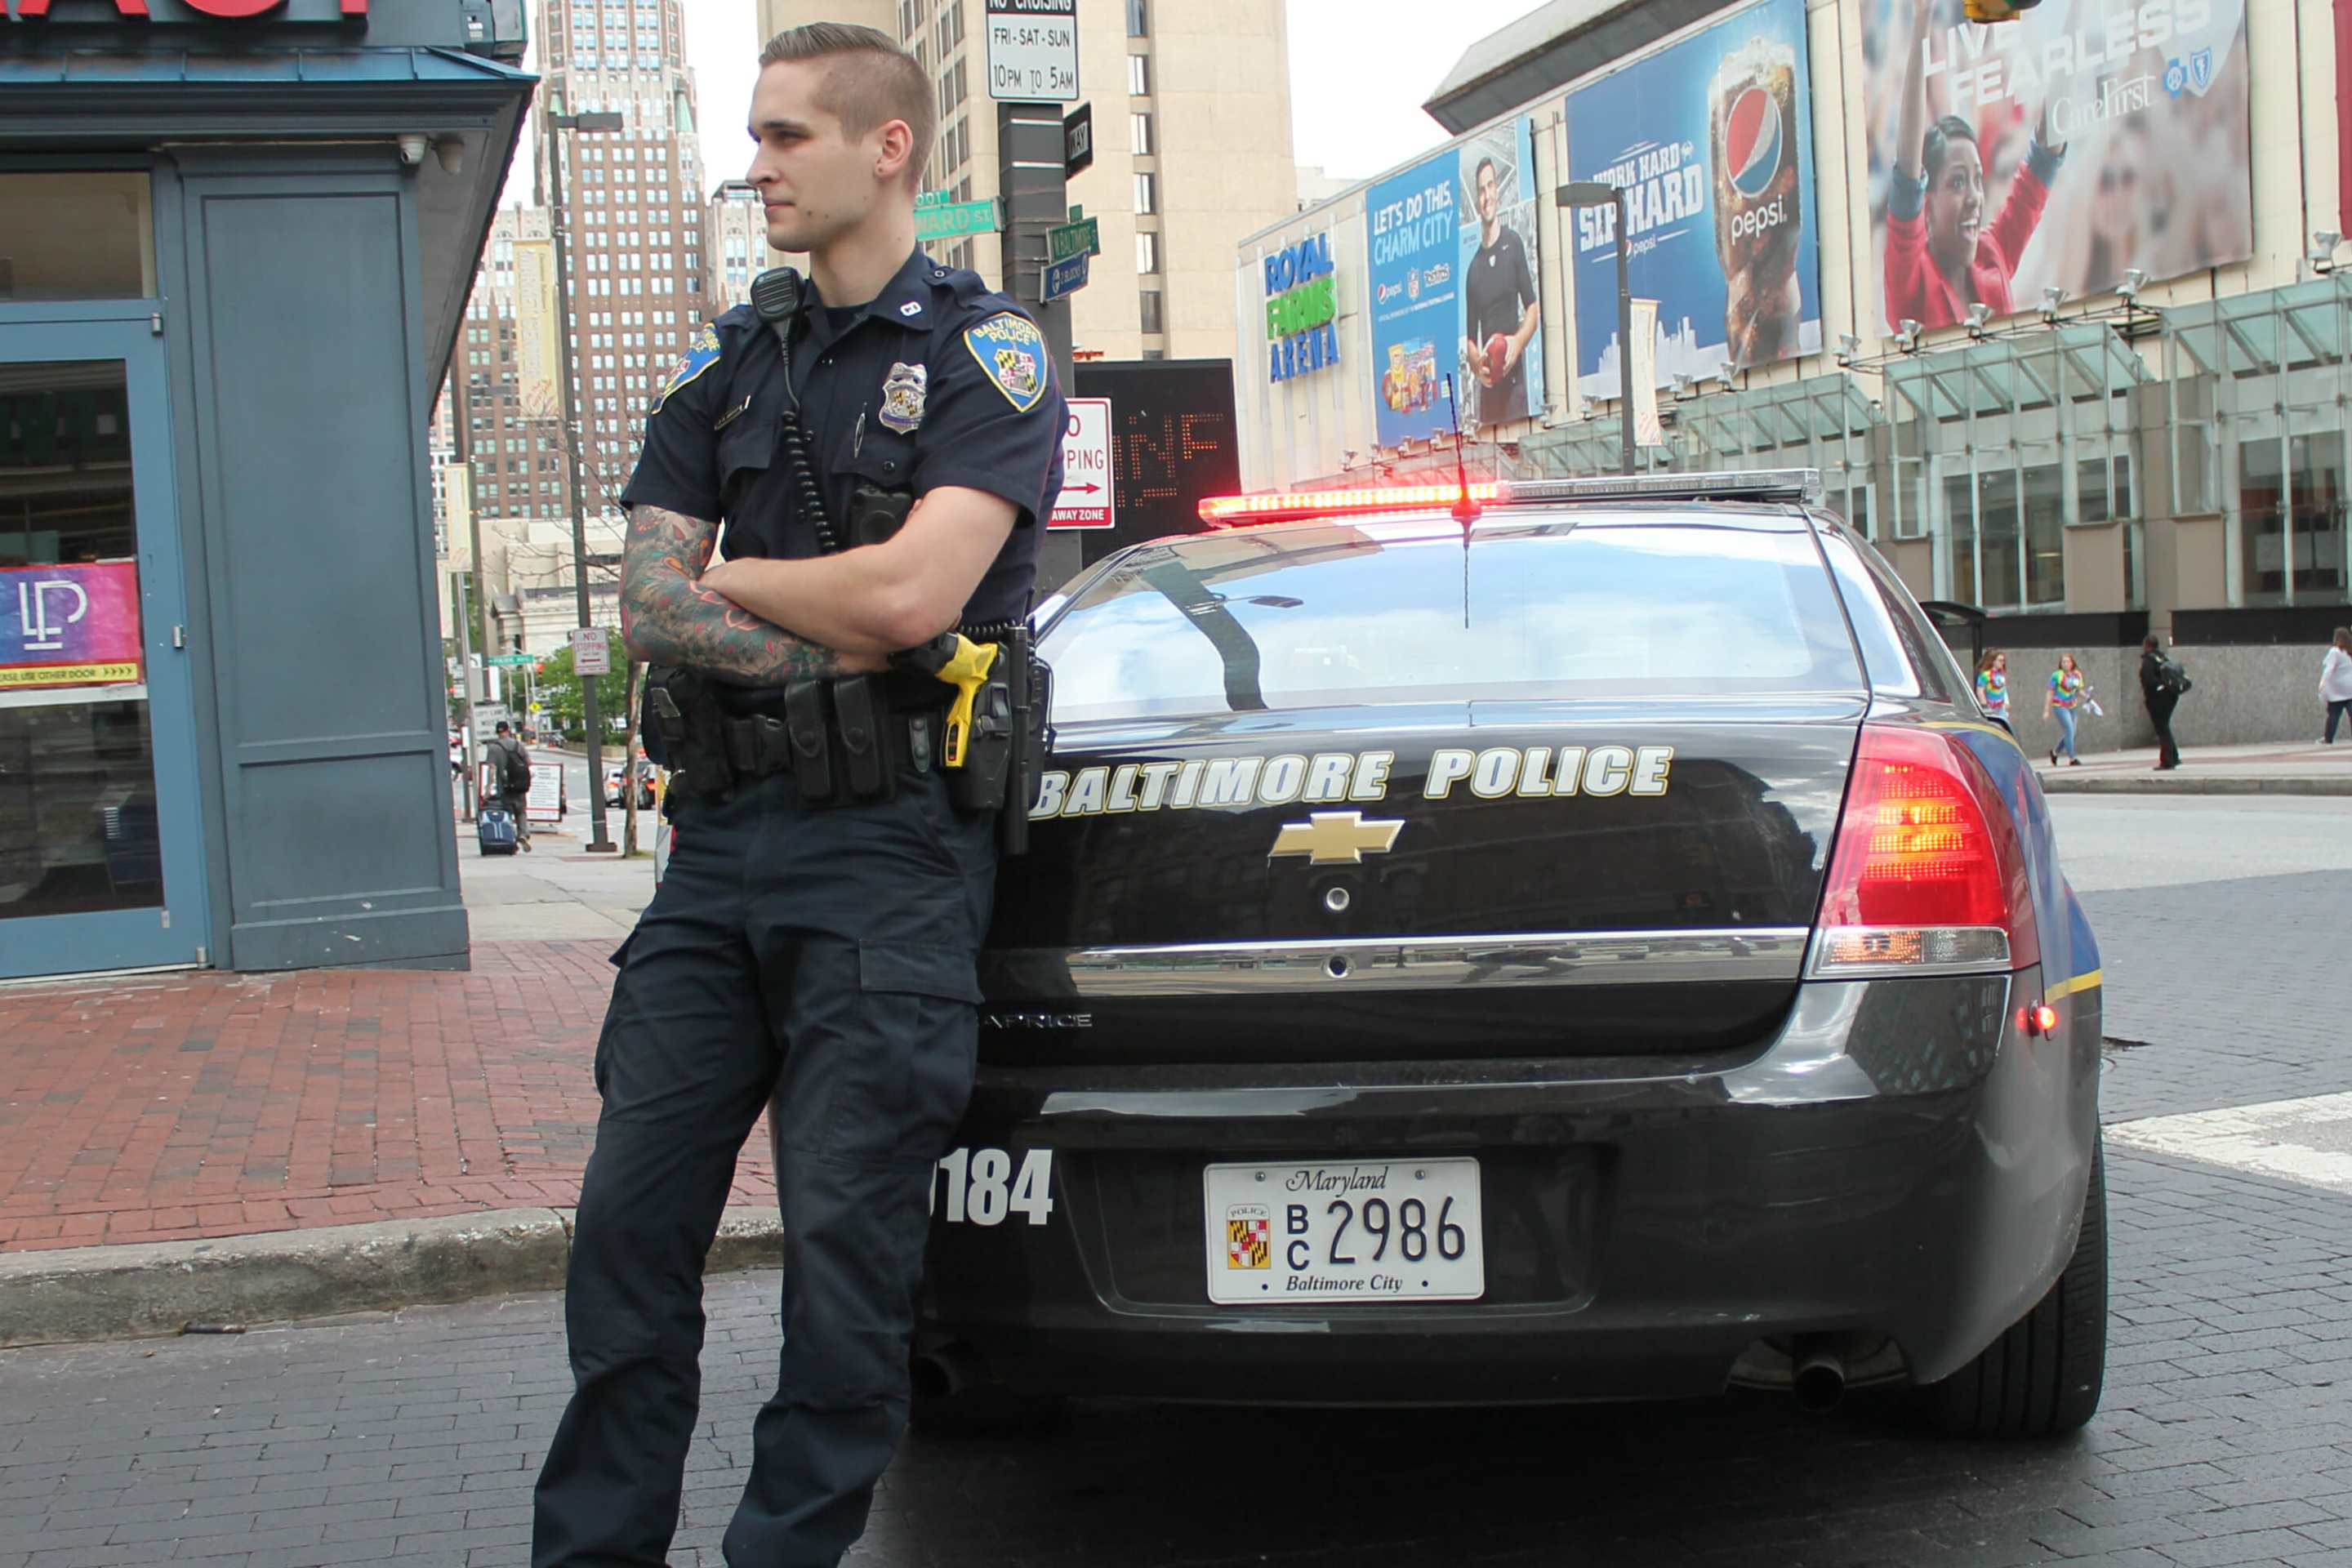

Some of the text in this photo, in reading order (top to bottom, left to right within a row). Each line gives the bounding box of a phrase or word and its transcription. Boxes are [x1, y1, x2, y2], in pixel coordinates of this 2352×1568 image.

[1922, 20, 2021, 78] LIVE
[1950, 0, 2212, 115] FEARLESS
[994, 65, 1074, 90] 10PM TO 5AM
[2051, 74, 2157, 135] CareFirst
[1638, 142, 1681, 182] HARD
[1374, 200, 1404, 236] LET'S
[1406, 193, 1423, 223] DO
[1579, 163, 1704, 252] SIP HARD
[1731, 193, 1784, 247] pepsi
[1264, 233, 1334, 296] ROYAL
[1374, 209, 1454, 266] CHARM CITY
[1633, 234, 1657, 258] pepsi
[973, 317, 1037, 342] BALTIMORE
[1266, 277, 1336, 340] FARMS
[989, 329, 1030, 346] POLICE
[1270, 322, 1339, 384] ARENA
[1052, 509, 1105, 521] AWAY ZONE
[38, 670, 66, 679] OTHER
[68, 669, 96, 678] DOOR
[1027, 746, 1675, 820] BALTIMORE POLICE
[929, 1147, 1054, 1226] 184
[1285, 1166, 1389, 1198] Maryland
[1231, 1208, 1267, 1218] POLICE
[1327, 1196, 1466, 1265] 2986
[1286, 1274, 1402, 1294] Baltimore City
